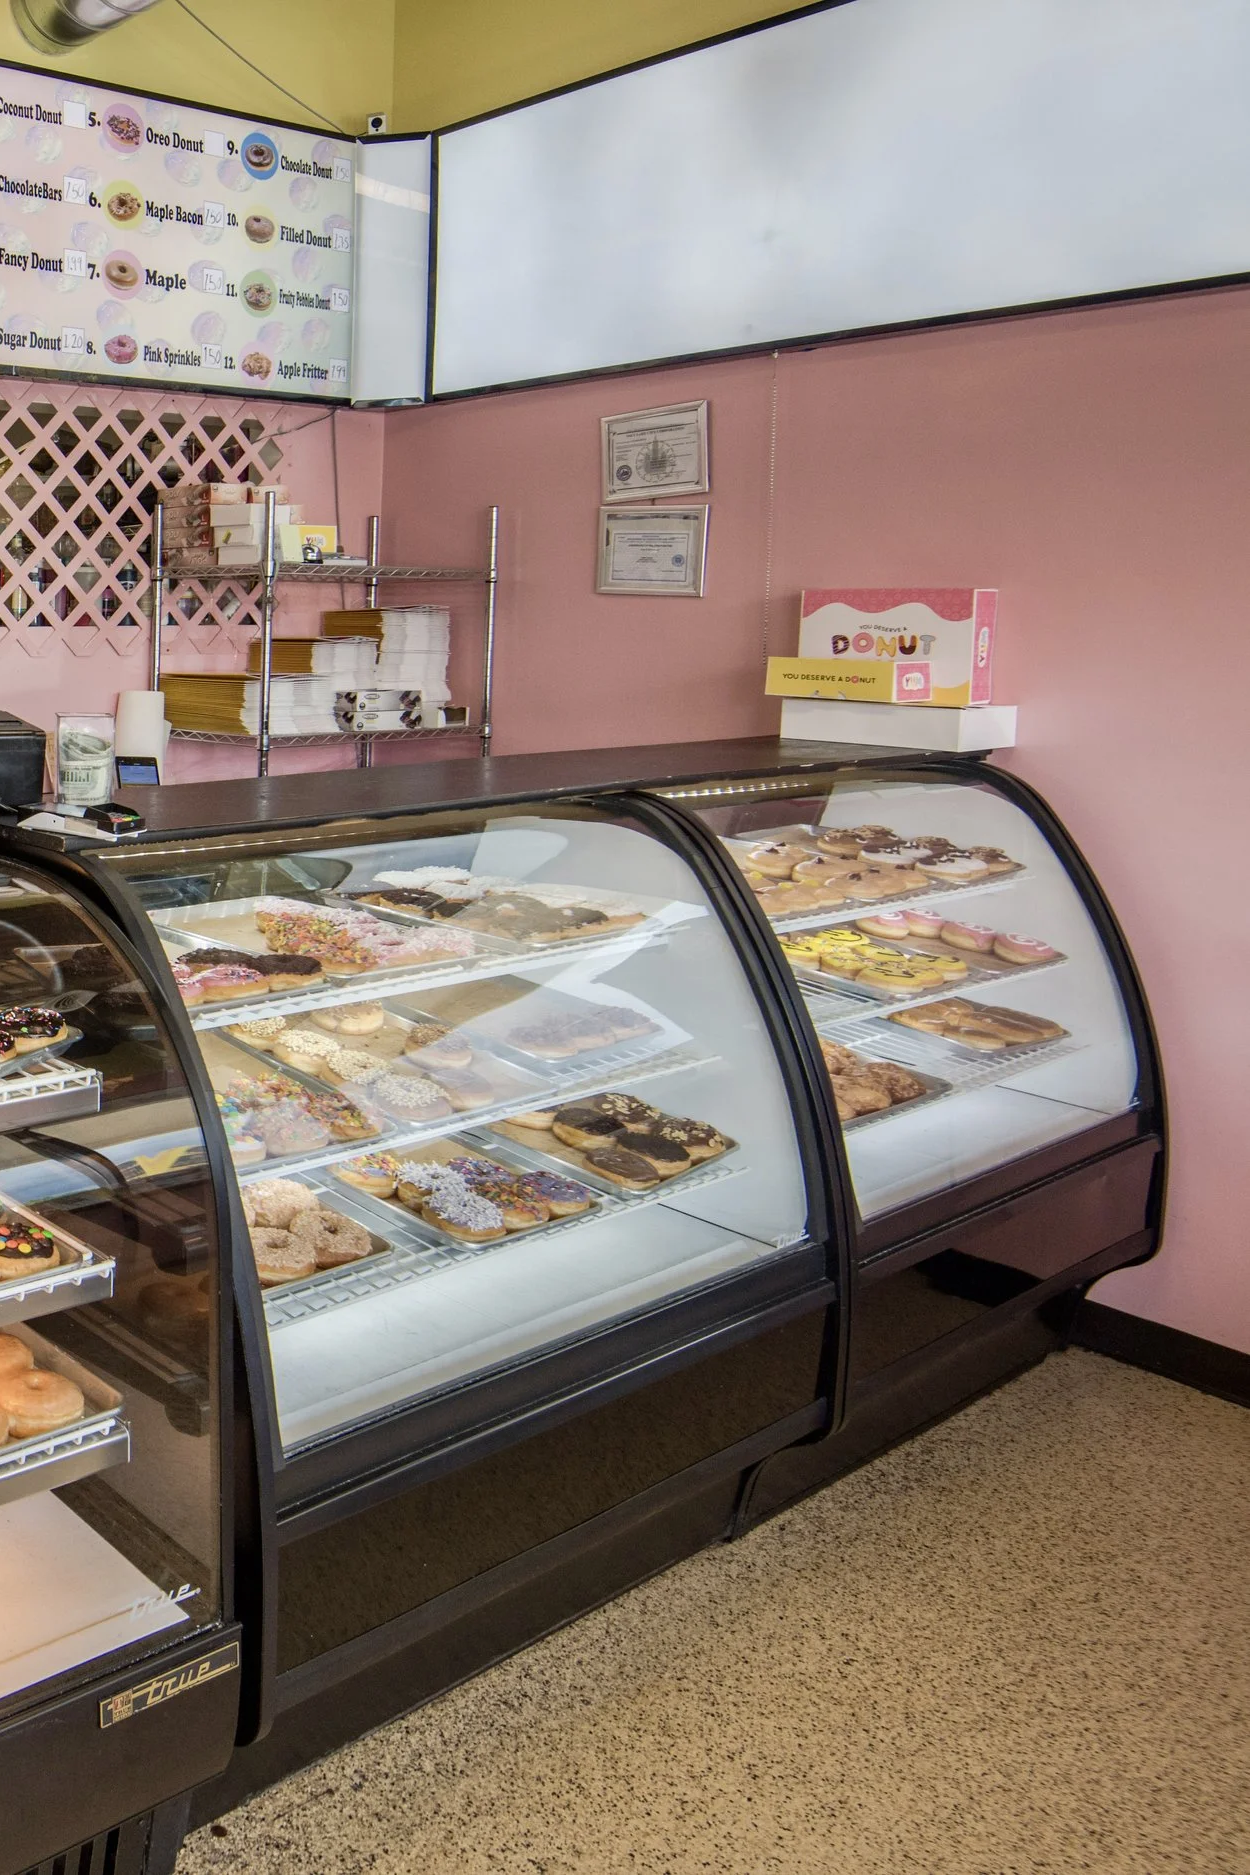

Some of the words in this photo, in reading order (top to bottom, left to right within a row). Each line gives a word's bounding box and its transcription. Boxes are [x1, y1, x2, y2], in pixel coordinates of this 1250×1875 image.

[35, 103, 63, 126] Donut
[88, 112, 101, 127] 5.
[145, 127, 171, 146] Oreo
[172, 132, 204, 154] Donut
[226, 140, 239, 156] 9.
[280, 154, 312, 177] Chocolate
[312, 161, 333, 180] Donut
[88, 191, 102, 209] 6.
[145, 200, 174, 221] Maple
[175, 205, 204, 226] Bacon
[226, 212, 239, 227] 10.
[280, 225, 305, 244] Filled
[305, 229, 332, 249] Donut
[31, 252, 63, 273] Donut
[87, 263, 100, 280] 7.
[145, 268, 187, 292] Maple
[225, 283, 238, 298] 11.
[279, 288, 296, 309] Fruity
[296, 290, 315, 309] Pebbles
[29, 331, 62, 352] Donut
[86, 340, 96, 355] 8.
[143, 345, 163, 363] Pink
[163, 349, 201, 368] Sprinkles
[223, 355, 236, 370] 12.
[277, 360, 301, 379] Apple
[302, 362, 329, 381] Fritter
[831, 631, 937, 658] DONUT
[800, 673, 836, 682] DESERVE
[845, 675, 877, 684] DONUT
